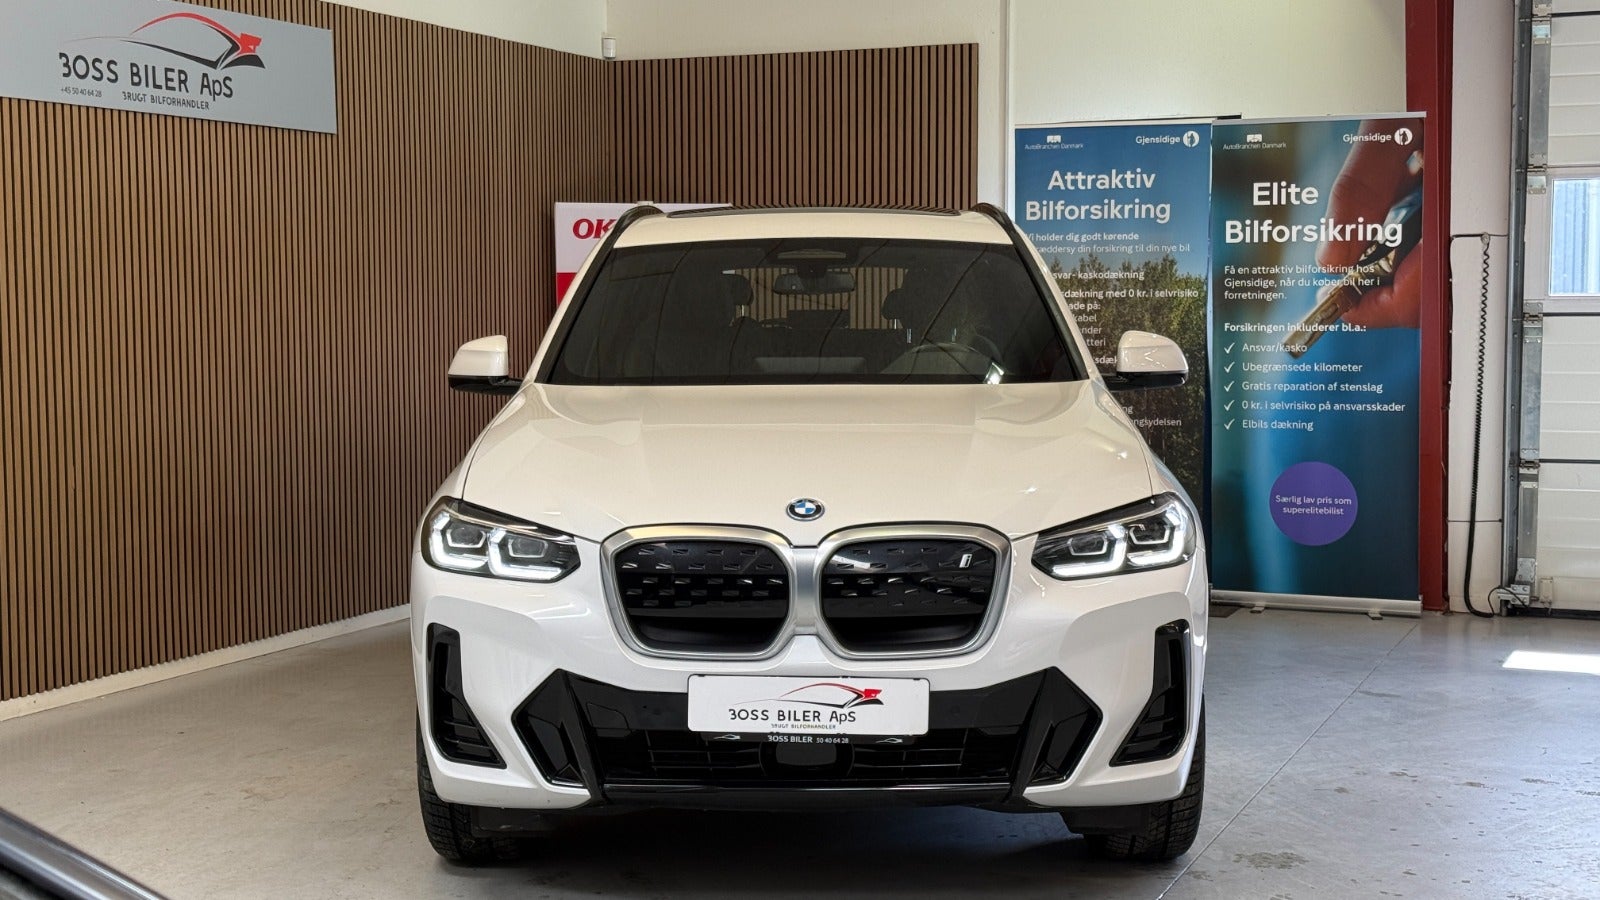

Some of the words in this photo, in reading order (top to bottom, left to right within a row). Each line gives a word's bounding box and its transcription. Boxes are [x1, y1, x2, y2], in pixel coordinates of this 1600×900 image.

[130, 62, 189, 93] BILER
[200, 72, 233, 101] ApS
[72, 87, 79, 95] 50
[80, 88, 87, 96] 40
[87, 89, 94, 97] 64
[95, 90, 102, 98] 28
[151, 95, 210, 110] BILFORHANDLER
[1135, 135, 1181, 145] Gjensidige
[1343, 133, 1392, 144] Gjensidige
[1048, 168, 1156, 190] Attraktiv
[1252, 181, 1319, 206] Elite
[1025, 198, 1171, 224] Bilforsikring
[1036, 233, 1064, 241] holder
[1066, 232, 1080, 243] dig
[1081, 232, 1102, 243] godt
[1103, 232, 1140, 241] kørende
[1225, 217, 1403, 248] Bilforsikring
[1036, 245, 1075, 255] ræddersy
[1078, 245, 1091, 253] din
[1093, 244, 1134, 255] forsikring
[1135, 244, 1144, 252] til
[1146, 243, 1159, 252] din
[1161, 245, 1177, 254] nye
[1179, 243, 1190, 252] bil
[1051, 271, 1076, 280] svar-
[1078, 270, 1145, 282] kaskodækning
[1224, 265, 1236, 274] Få
[1252, 265, 1294, 274] attraktiv
[1295, 264, 1354, 276] bilforsikring
[1356, 265, 1375, 273] hos
[1224, 278, 1277, 290] Gjensidige,
[1280, 278, 1296, 287] når
[1298, 278, 1310, 287] du
[1312, 278, 1341, 287] køber
[1343, 277, 1355, 287] bil
[1358, 277, 1375, 287] her
[1061, 290, 1104, 301] dækning
[1105, 290, 1126, 299] med
[1128, 290, 1135, 298] 0
[1137, 289, 1148, 299] kr.
[1155, 289, 1199, 298] selvrisiko
[1224, 291, 1288, 302] forretningen.
[1068, 302, 1085, 311] ade
[1087, 301, 1101, 313] på:
[1073, 313, 1097, 323] kabel
[1080, 326, 1102, 335] nder
[1224, 323, 1285, 335] Forsikringen
[1287, 322, 1339, 333] inkluderer
[1341, 323, 1367, 333] bl.a.:
[1086, 338, 1106, 348] tteri
[1242, 343, 1308, 353] Ansvar/kasko
[1242, 362, 1312, 374] Ubegrænsede
[1314, 363, 1363, 373] kilometer
[1242, 382, 1272, 391] Gratis
[1274, 383, 1324, 393] reparation
[1327, 382, 1338, 391] af
[1340, 383, 1383, 394] stenslag
[1242, 401, 1249, 410] 0
[1250, 401, 1263, 410] kr.
[1270, 401, 1317, 411] selvrisiko
[1318, 402, 1331, 413] på
[1333, 402, 1406, 413] ansvarsskader
[1131, 418, 1182, 428] ngsydelsen
[1242, 420, 1269, 429] Elbils
[1271, 420, 1314, 431] dækning
[1275, 494, 1302, 505] Særlig
[1303, 495, 1316, 503] lav
[1317, 495, 1333, 506] pris
[1334, 497, 1352, 505] som
[1283, 506, 1344, 517] superelitebilist
[777, 710, 821, 722] BILER
[829, 711, 856, 725] ApS
